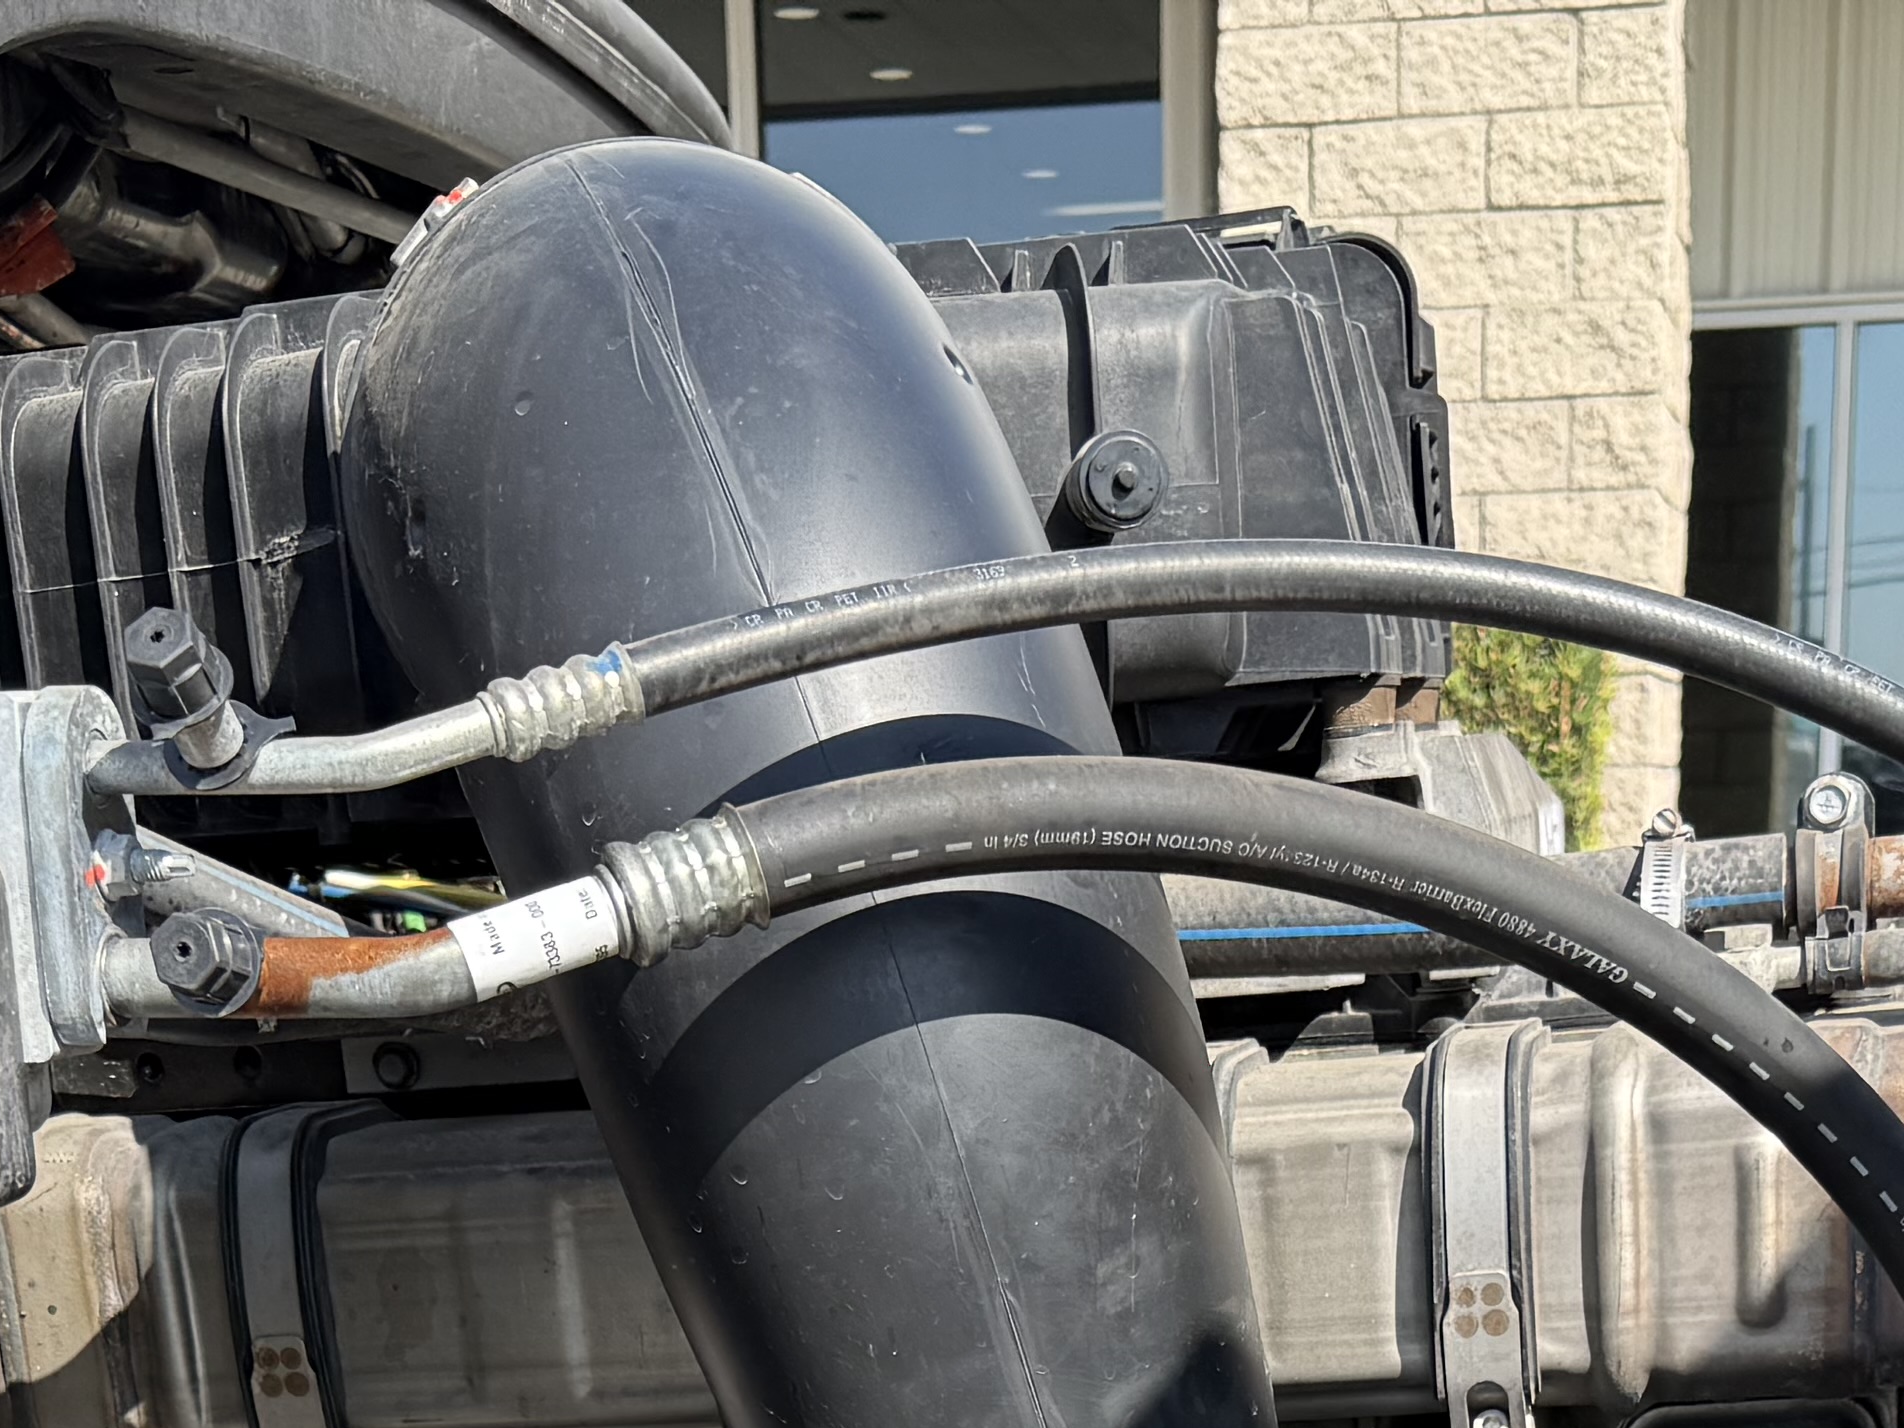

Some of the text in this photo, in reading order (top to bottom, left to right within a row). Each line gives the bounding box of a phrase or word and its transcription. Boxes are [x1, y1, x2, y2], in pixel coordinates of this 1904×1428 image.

[1003, 831, 1029, 849] 3/4
[1034, 827, 1097, 849] (19mm)
[1100, 830, 1152, 848] HOSE
[1156, 832, 1232, 854] SUCTION
[1238, 840, 1267, 860] A/C
[1409, 879, 1499, 924] FlexBarrier
[1499, 911, 1537, 939] 4880
[1536, 929, 1629, 984] GALAXY
